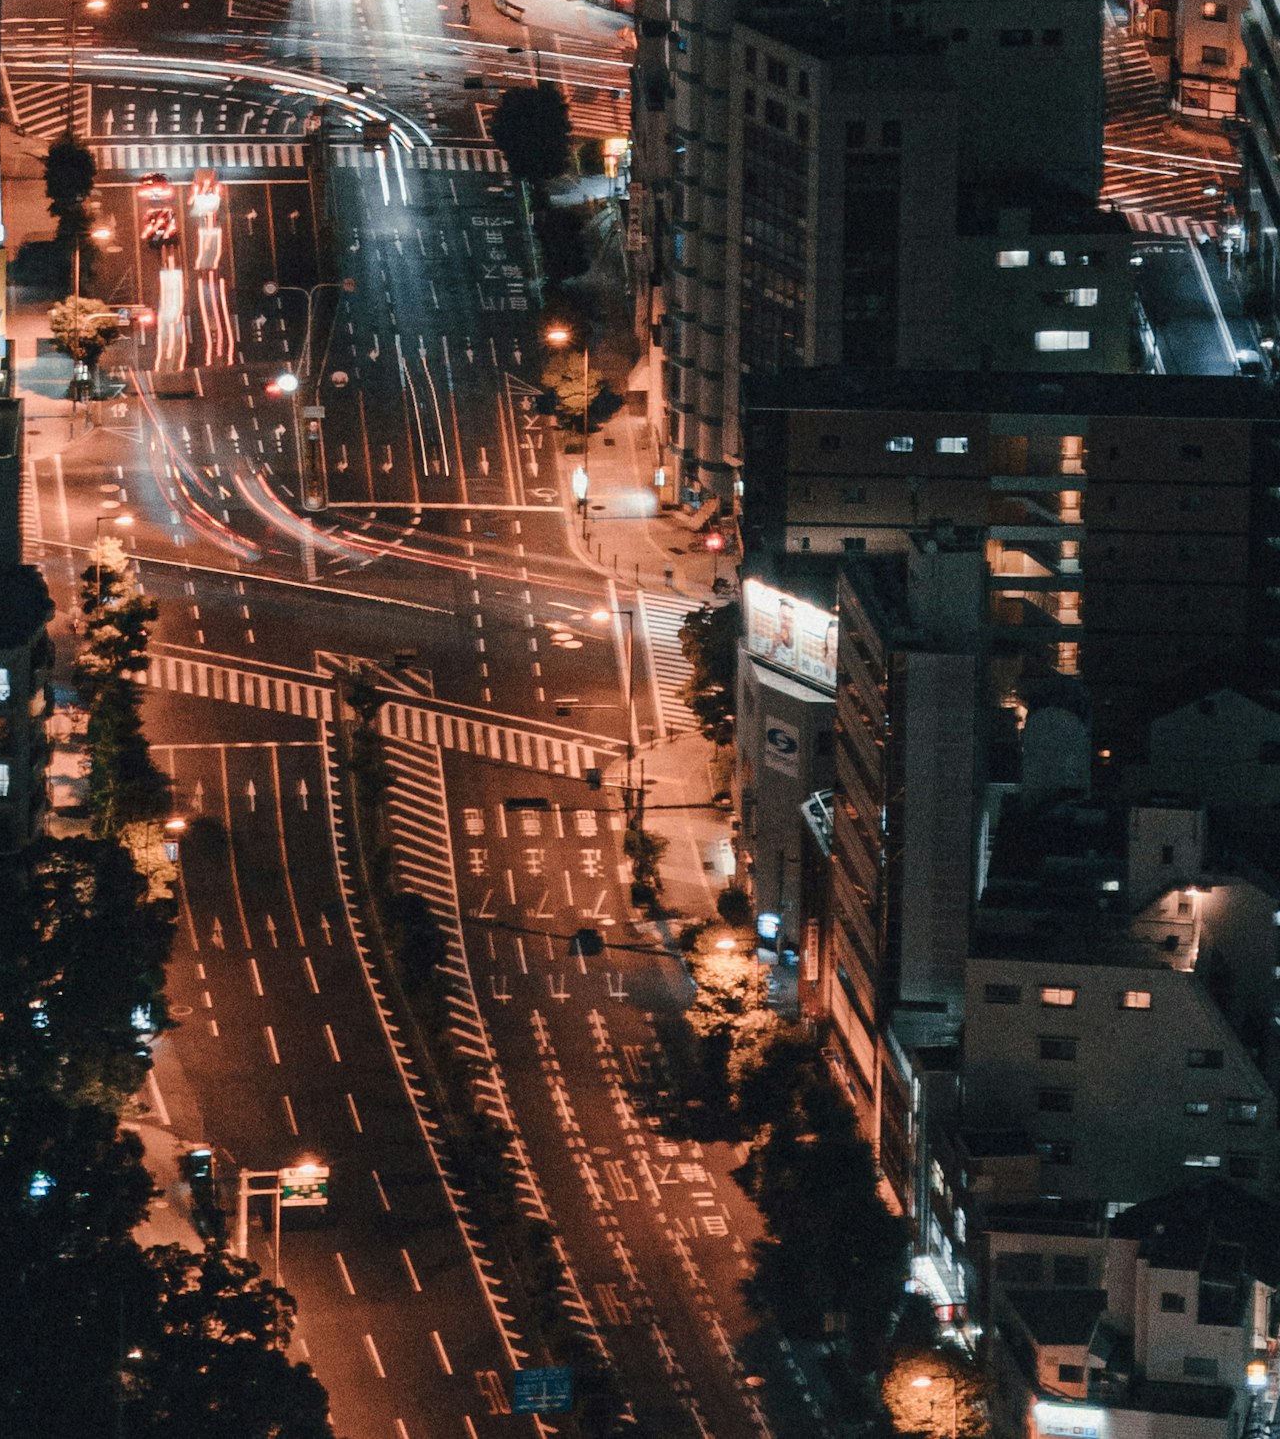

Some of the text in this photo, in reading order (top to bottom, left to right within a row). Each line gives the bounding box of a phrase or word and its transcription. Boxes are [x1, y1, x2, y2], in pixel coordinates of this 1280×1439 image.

[604, 1159, 639, 1202] 50
[594, 1283, 632, 1326] 50
[474, 1370, 513, 1416] 50
